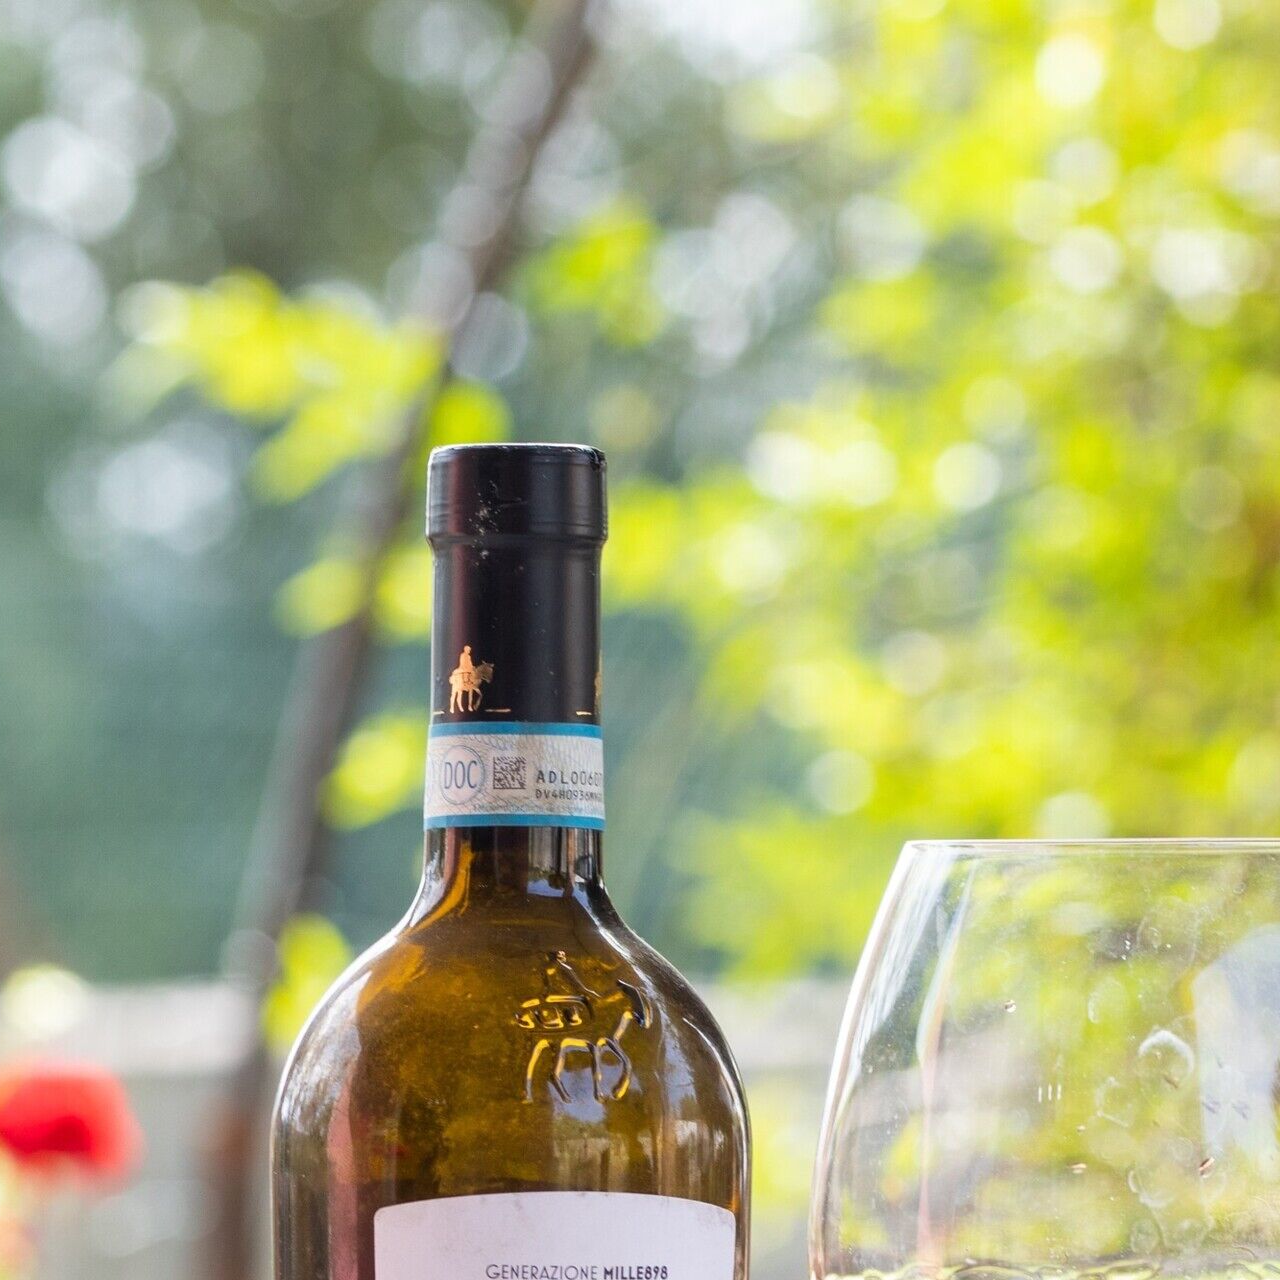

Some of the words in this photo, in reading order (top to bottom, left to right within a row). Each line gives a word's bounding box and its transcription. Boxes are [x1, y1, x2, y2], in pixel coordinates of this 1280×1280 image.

[444, 760, 477, 789] DOC
[485, 1263, 599, 1280] GENERAZIONE
[603, 1265, 669, 1280] MILLE898
